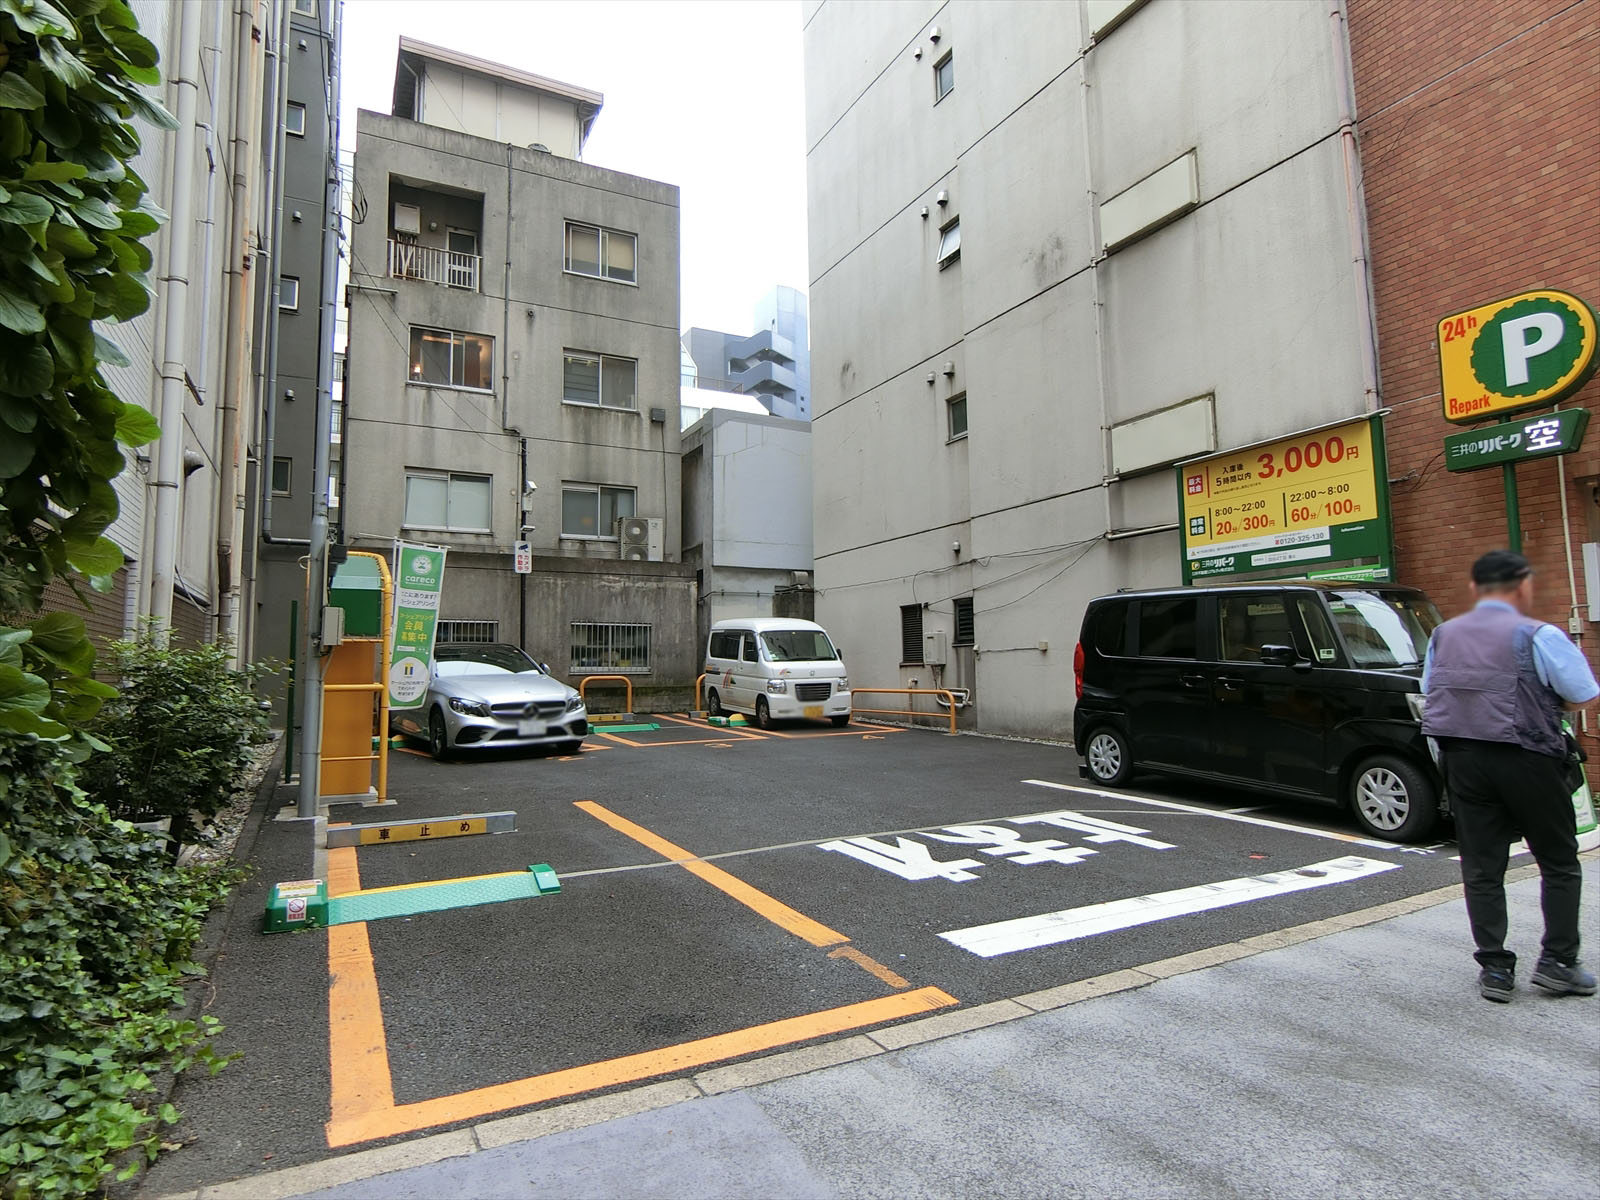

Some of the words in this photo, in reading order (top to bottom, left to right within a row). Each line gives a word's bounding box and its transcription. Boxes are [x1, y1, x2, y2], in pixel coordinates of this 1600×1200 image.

[1442, 316, 1477, 343] 24h
[1501, 312, 1564, 388] P
[1449, 394, 1491, 416] Repark
[1524, 419, 1562, 452] 空
[1451, 432, 1522, 457] 三井のリパーク
[1256, 436, 1360, 480] 3,000円
[1222, 463, 1244, 475] 入庫後
[1187, 476, 1202, 487] 最大
[1215, 472, 1252, 487] 5時間以内
[1188, 485, 1203, 496] 料金
[1190, 517, 1205, 528] 通常
[1191, 526, 1206, 536] 料金
[1279, 532, 1324, 545] 0120-325-130
[1201, 556, 1235, 569] 三井のリパーク
[404, 574, 436, 585] careco
[404, 620, 424, 631] 会員
[379, 821, 471, 841] 車止め
[816, 810, 1178, 883] 止まれ
